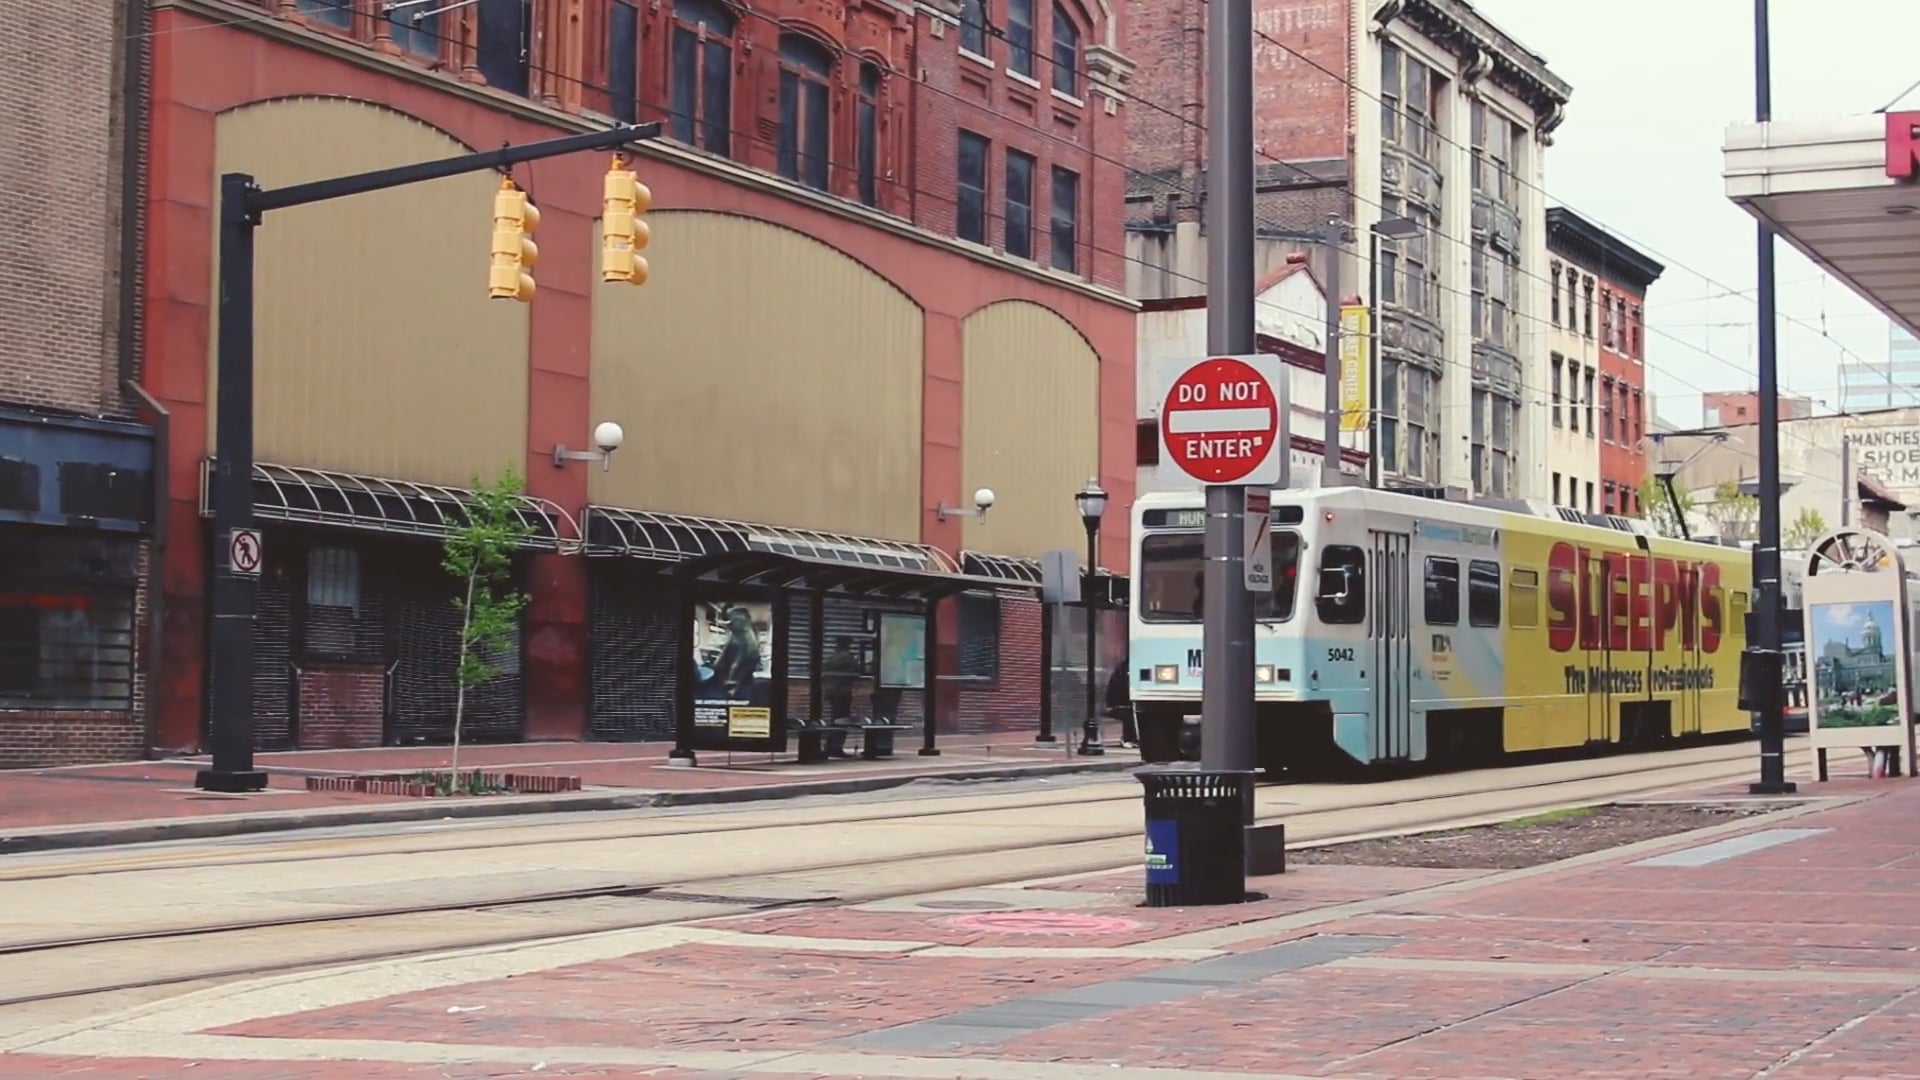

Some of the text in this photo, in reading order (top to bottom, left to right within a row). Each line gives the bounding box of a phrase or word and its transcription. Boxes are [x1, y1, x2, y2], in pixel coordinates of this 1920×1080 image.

[1179, 381, 1261, 403] DO NOT
[1186, 438, 1252, 459] ENTER
[1328, 648, 1354, 661] 5042
[1565, 665, 1585, 694] The
[1647, 664, 1713, 691] rofessionals
